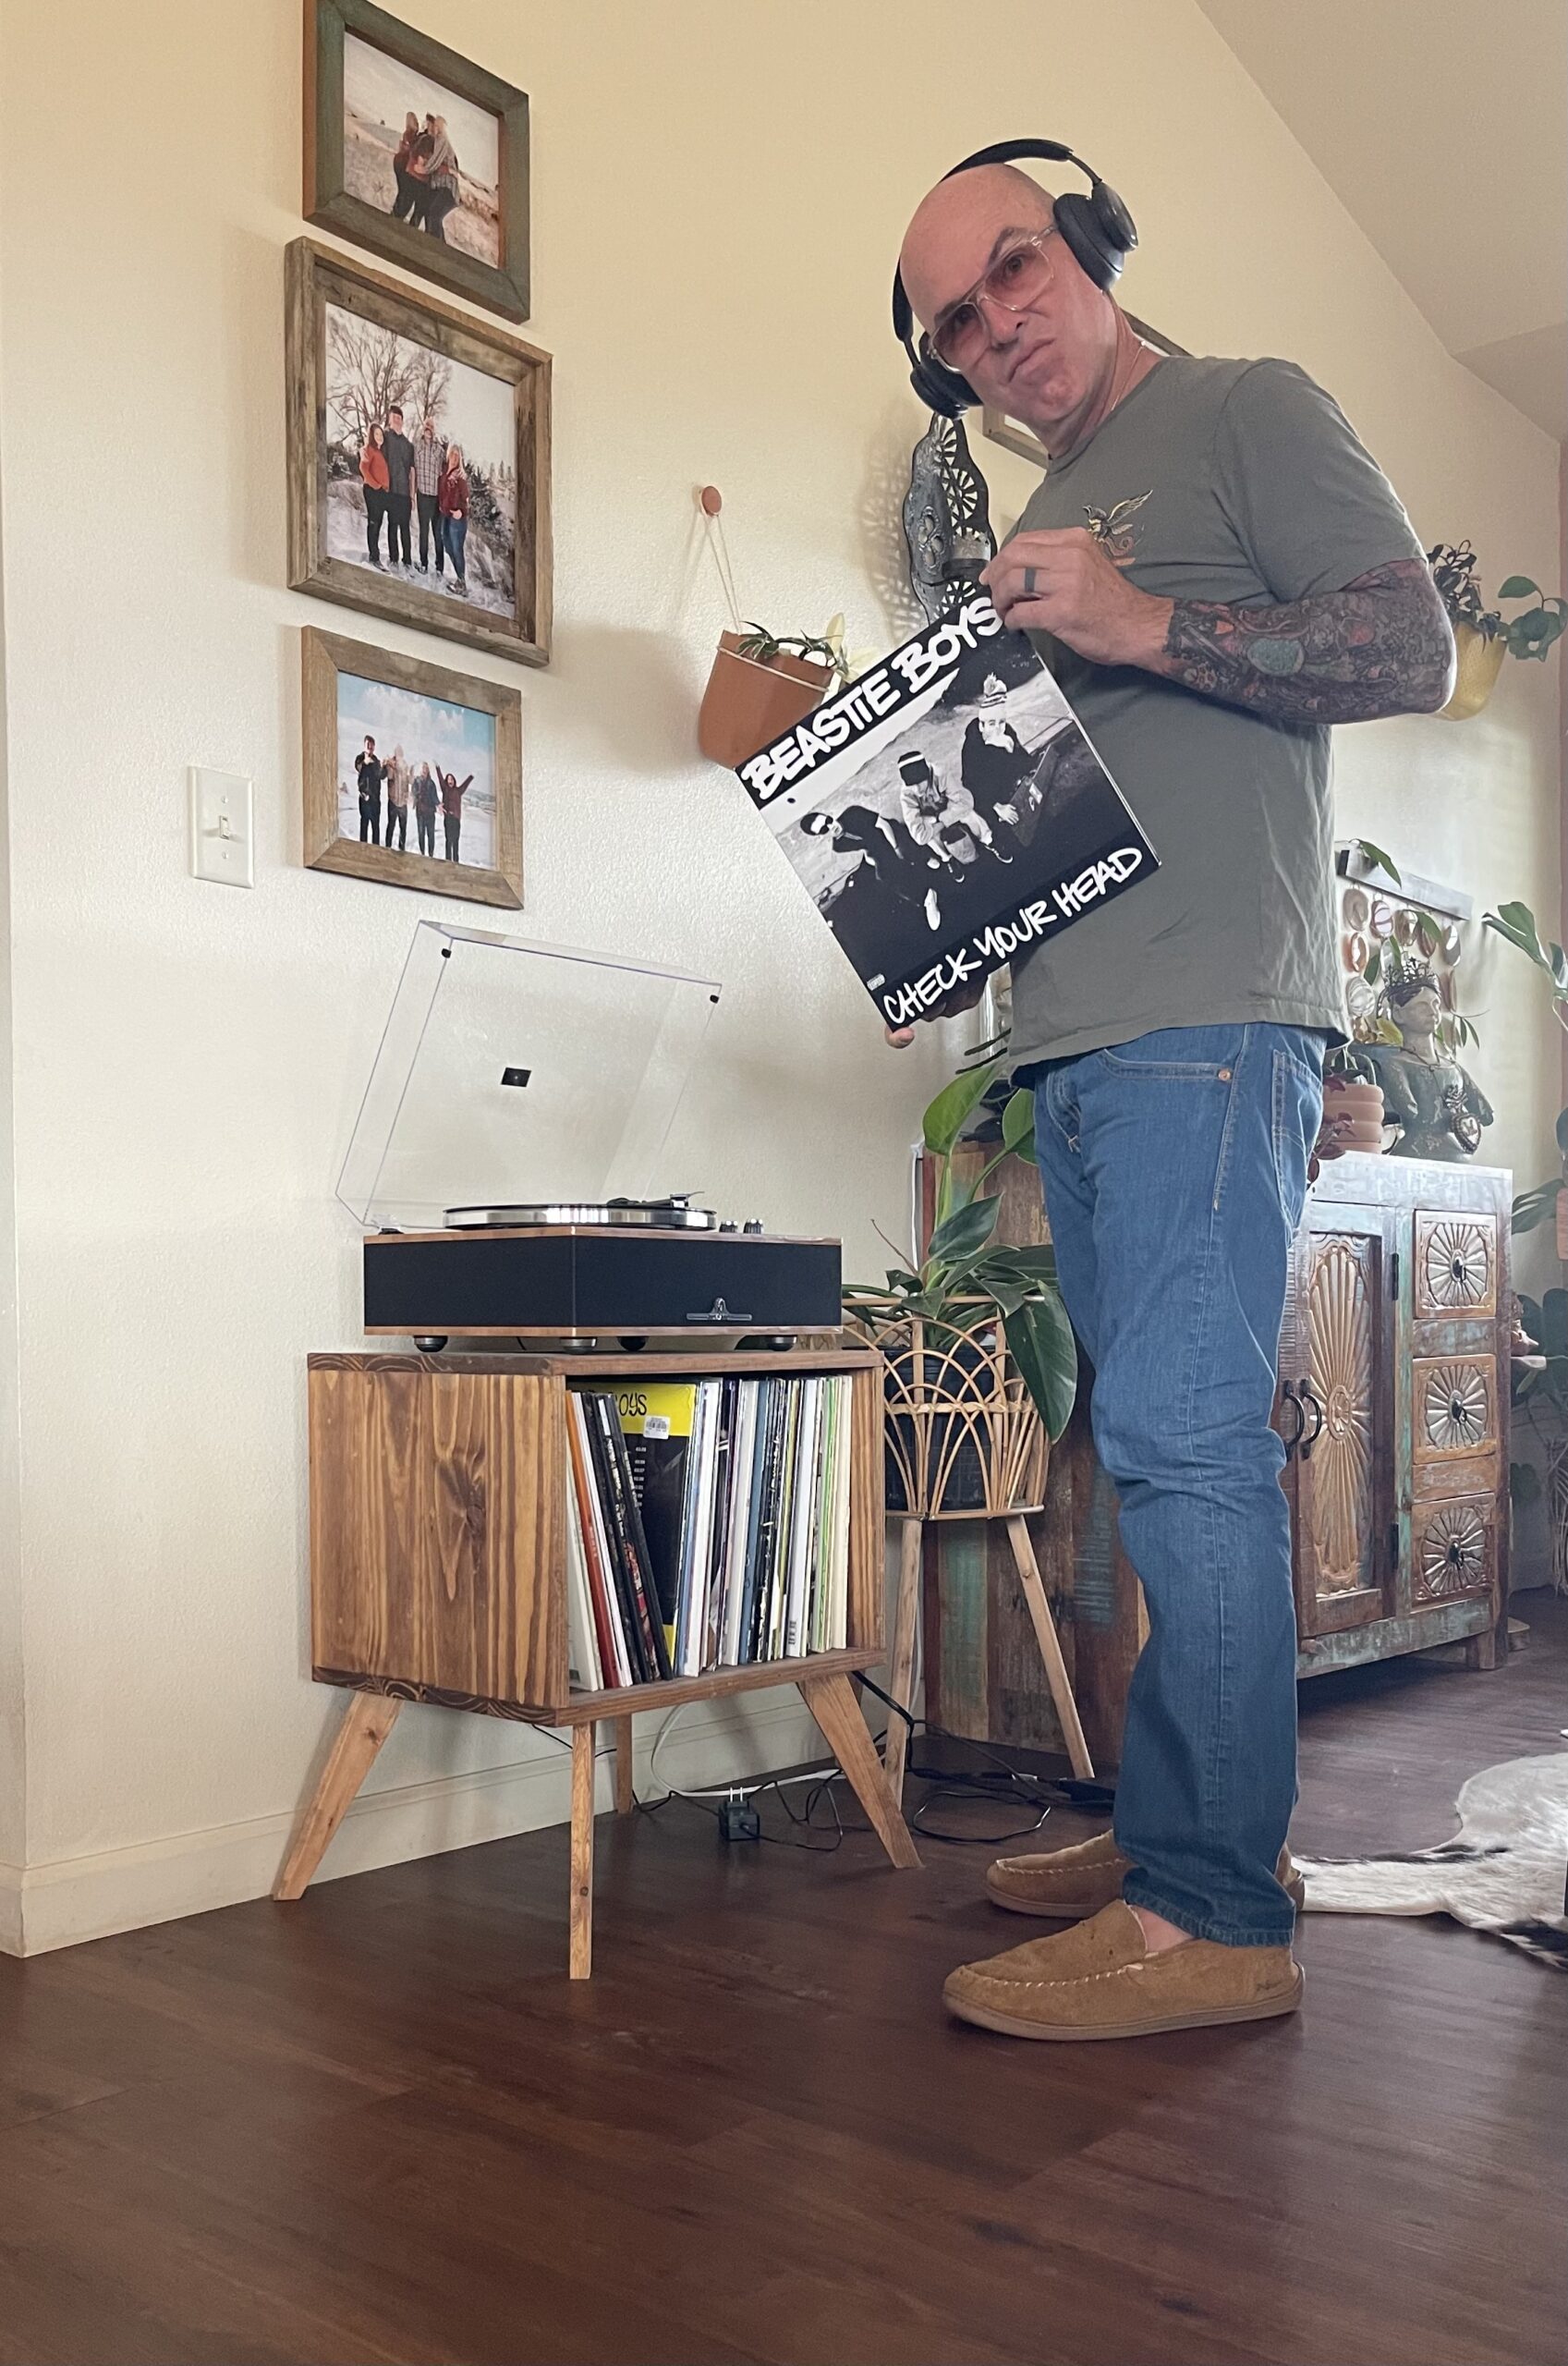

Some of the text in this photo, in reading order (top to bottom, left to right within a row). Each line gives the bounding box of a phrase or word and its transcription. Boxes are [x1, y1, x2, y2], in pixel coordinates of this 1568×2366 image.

[741, 596, 1003, 800] BEASTIE BOYS
[883, 847, 1144, 1024] CHECK YOUR HEAD
